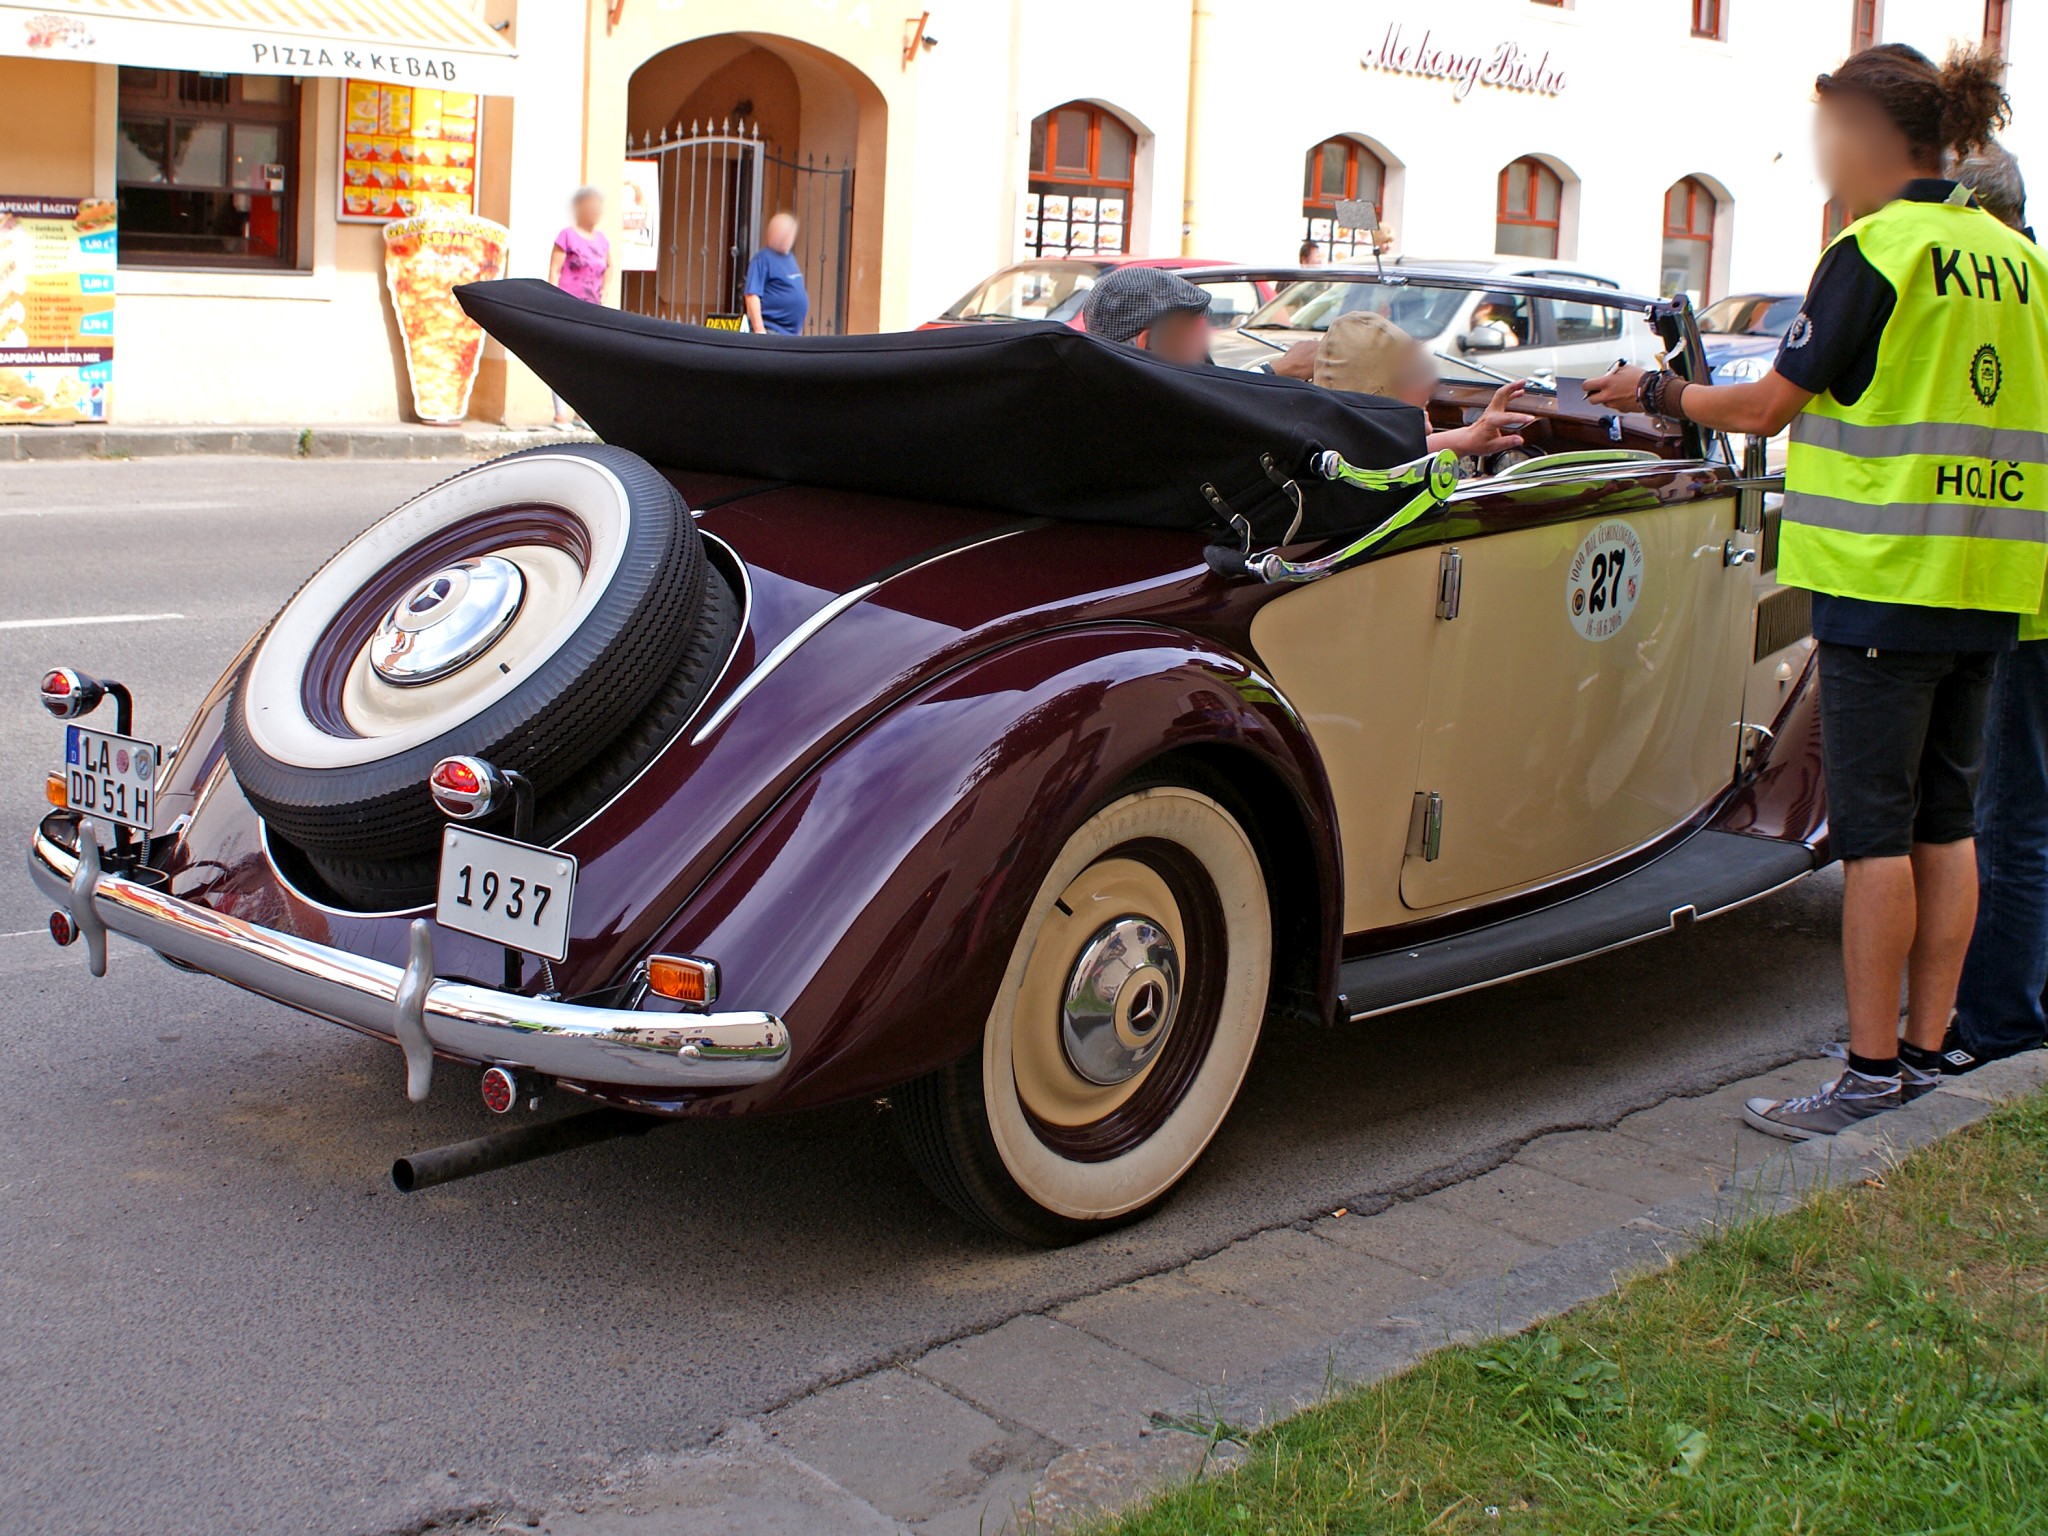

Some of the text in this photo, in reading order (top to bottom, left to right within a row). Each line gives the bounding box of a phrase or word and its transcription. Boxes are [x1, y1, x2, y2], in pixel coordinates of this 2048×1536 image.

[252, 42, 458, 82] PIZZA & KEBAB
[1364, 22, 1568, 99] Mekong Bistro
[42, 203, 78, 214] BAGETY
[1930, 246, 2030, 305] KHV
[705, 316, 742, 332] DENNÉ
[1936, 460, 2025, 503] HOLÍČ
[1570, 551, 1586, 583] 1000
[1588, 547, 1626, 615] 27
[71, 750, 77, 762] D
[85, 736, 111, 776] LA
[71, 770, 149, 824] DD 51 H
[456, 864, 552, 927] 1937
